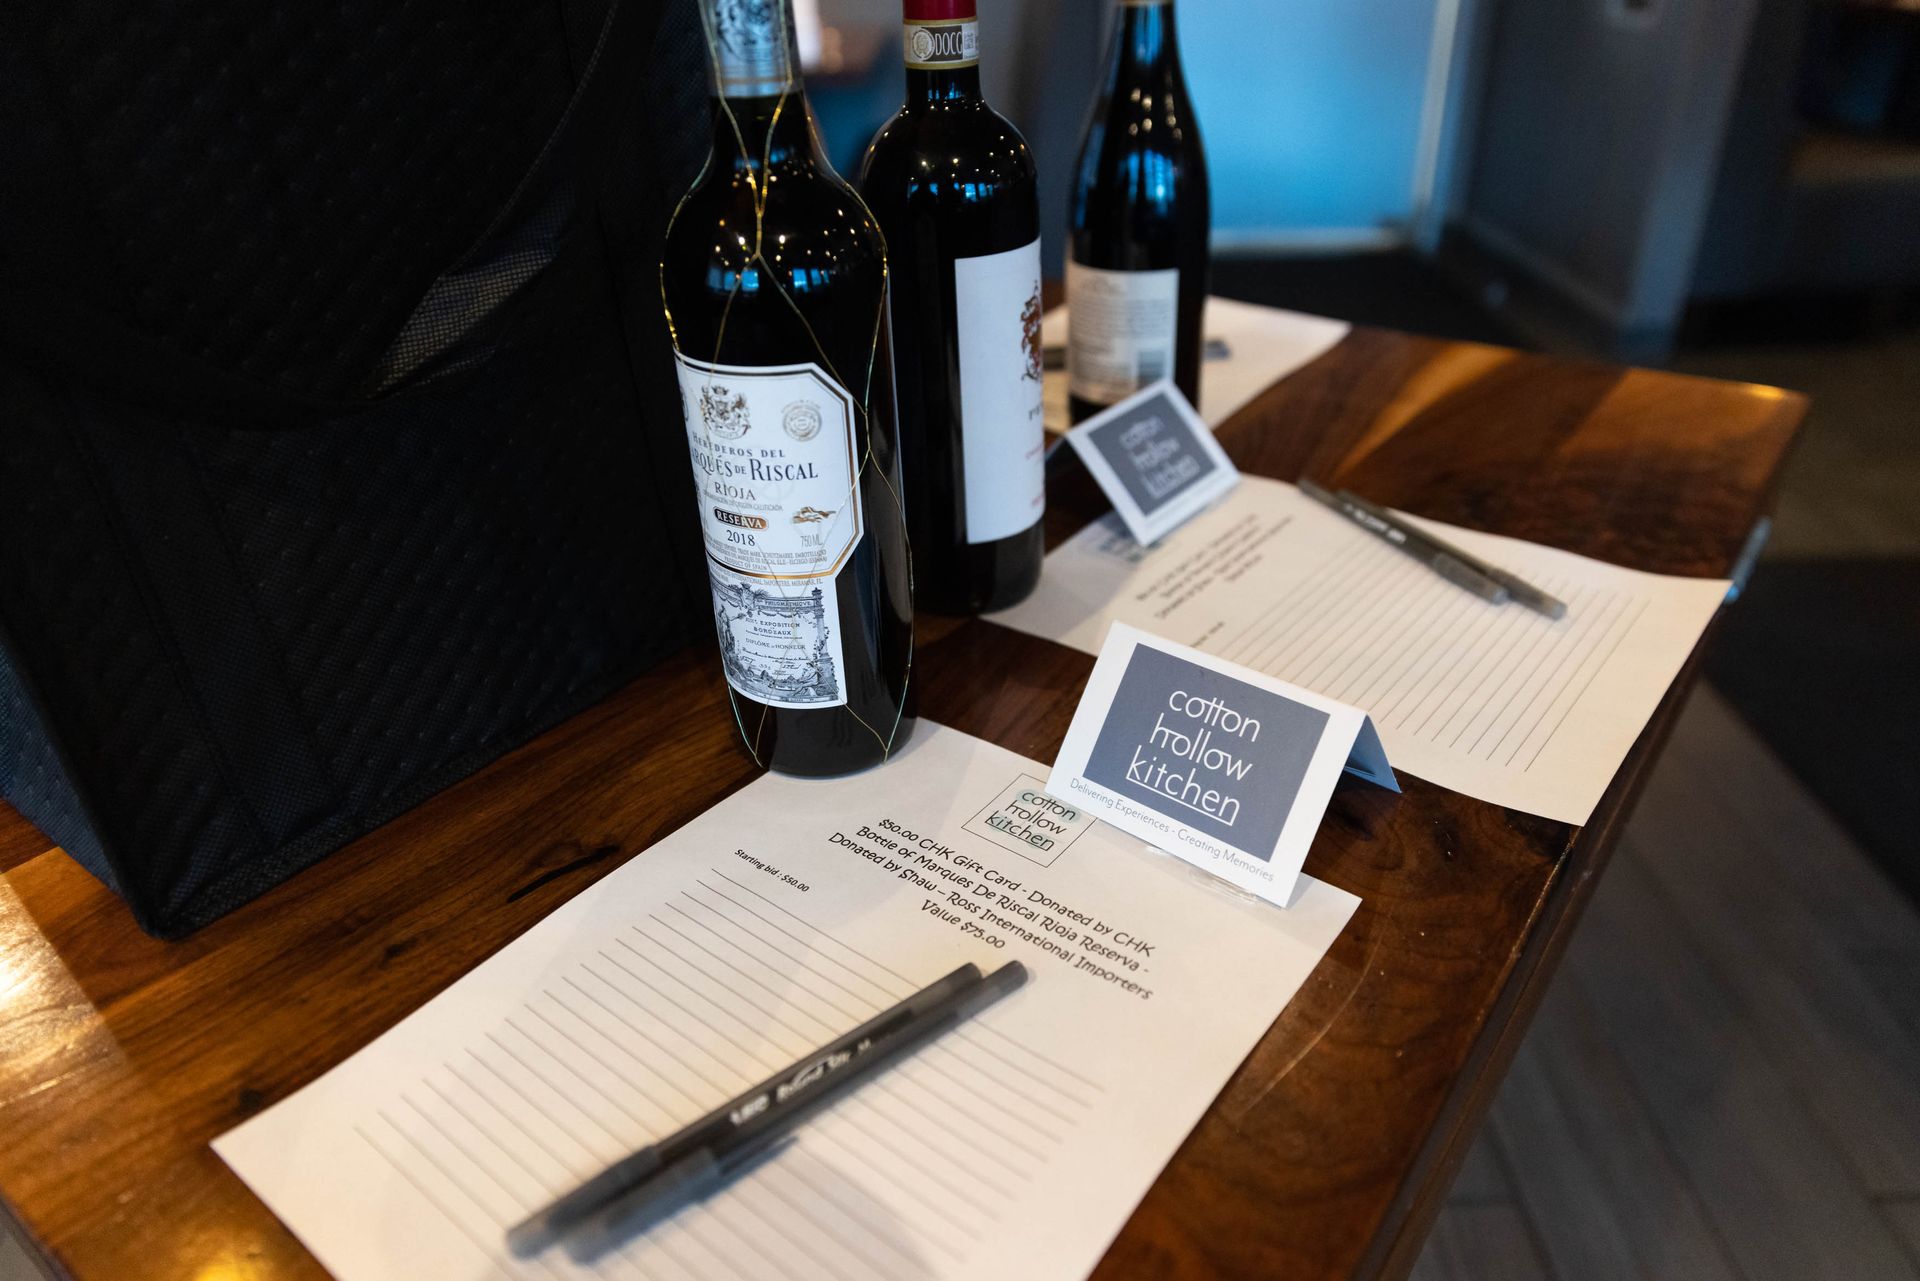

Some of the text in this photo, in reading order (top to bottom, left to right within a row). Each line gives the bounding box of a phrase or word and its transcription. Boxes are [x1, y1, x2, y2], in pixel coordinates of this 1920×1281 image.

[749, 458, 819, 481] RISCAL
[761, 449, 786, 458] DEL
[714, 481, 756, 501] RIOJA
[716, 509, 763, 529] RESERVA
[726, 529, 756, 547] 2018
[1169, 690, 1261, 742] cotton
[1149, 712, 1253, 781] hollow
[1021, 792, 1076, 821] cotton
[1125, 745, 1240, 826] kitchen
[984, 810, 1055, 851] kitchen
[1005, 800, 1067, 834] hollow
[1070, 777, 1114, 809] Delivering
[1115, 798, 1170, 833] Experiences
[1177, 828, 1221, 860] Creating
[1223, 847, 1274, 882] Memories
[734, 849, 765, 870] Starting
[764, 865, 780, 876] bid
[780, 874, 810, 892] $50.00
[878, 818, 919, 842] $50.00
[918, 838, 956, 860] CHK
[953, 855, 984, 874] Gift
[983, 869, 1022, 891] Card
[1027, 890, 1094, 926] Donated
[1093, 921, 1113, 936] by
[1113, 932, 1156, 957] CHK
[828, 832, 885, 864] Donated
[883, 860, 901, 873] by
[897, 868, 937, 892] Shaw
[946, 891, 981, 914] Ross
[978, 908, 1075, 962] International
[1073, 956, 1153, 999] Importers
[856, 826, 898, 851] Bottle
[914, 855, 973, 888] Marques
[972, 884, 997, 900] De
[995, 894, 1040, 922] Riscal
[1039, 916, 1078, 942] Rioja
[1079, 935, 1140, 972] Reserva
[921, 899, 1006, 949] Value $75.00
